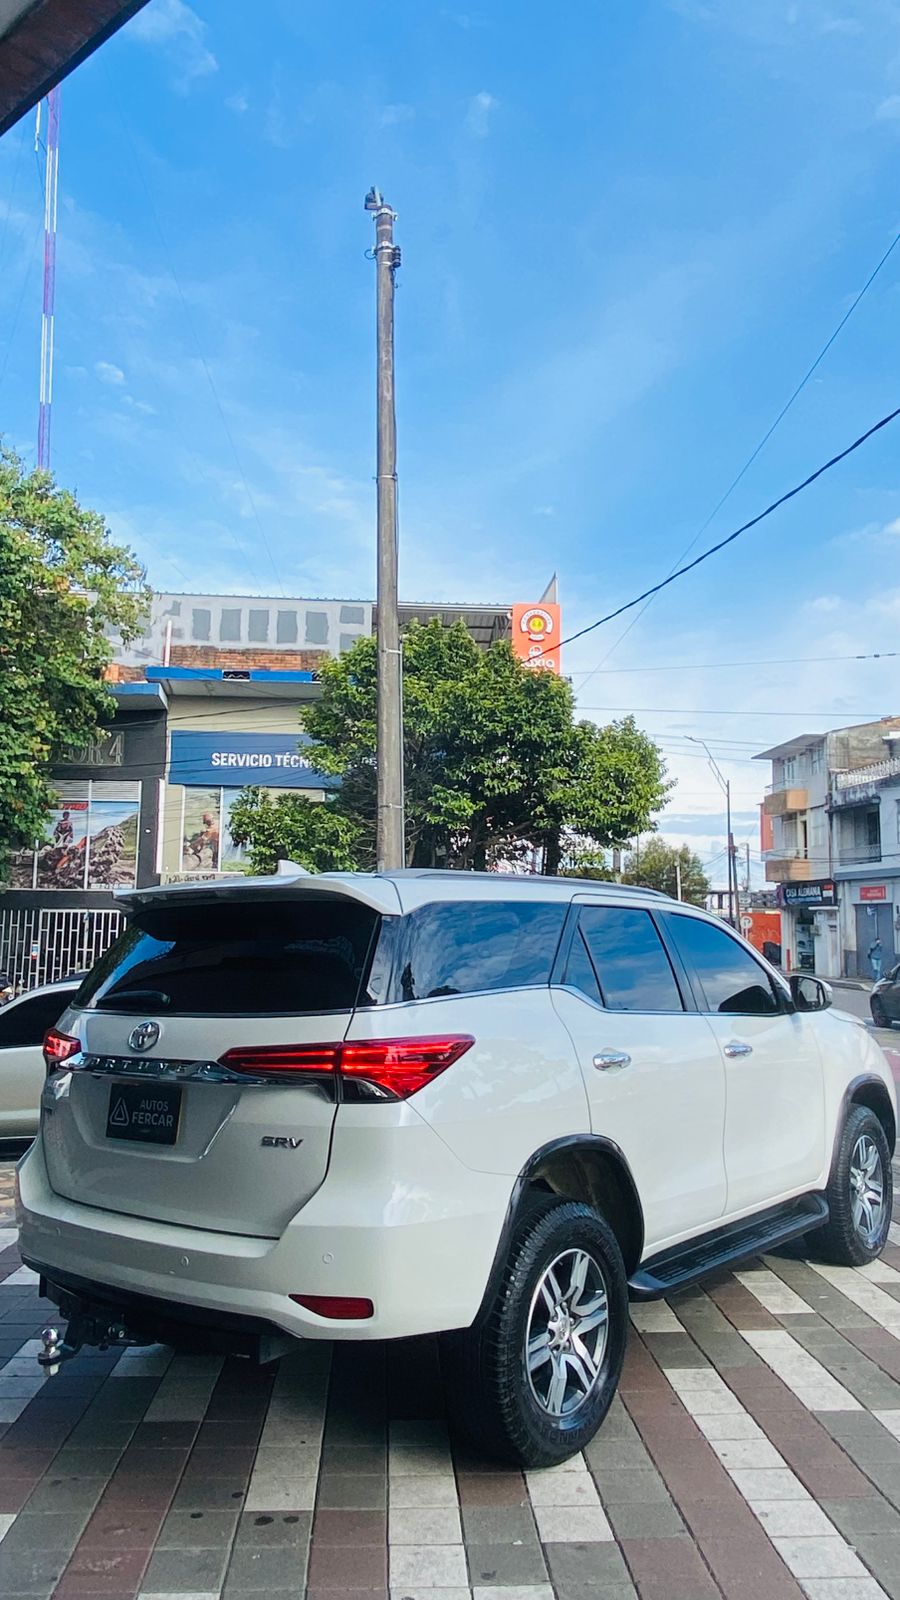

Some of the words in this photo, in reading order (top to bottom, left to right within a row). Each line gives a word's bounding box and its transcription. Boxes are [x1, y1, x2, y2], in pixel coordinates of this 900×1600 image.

[109, 731, 124, 766] 4
[211, 752, 272, 767] SERVICIO
[139, 1101, 169, 1112] AUTOS
[131, 1111, 174, 1128] FERCAR
[260, 1135, 304, 1149] SRV
